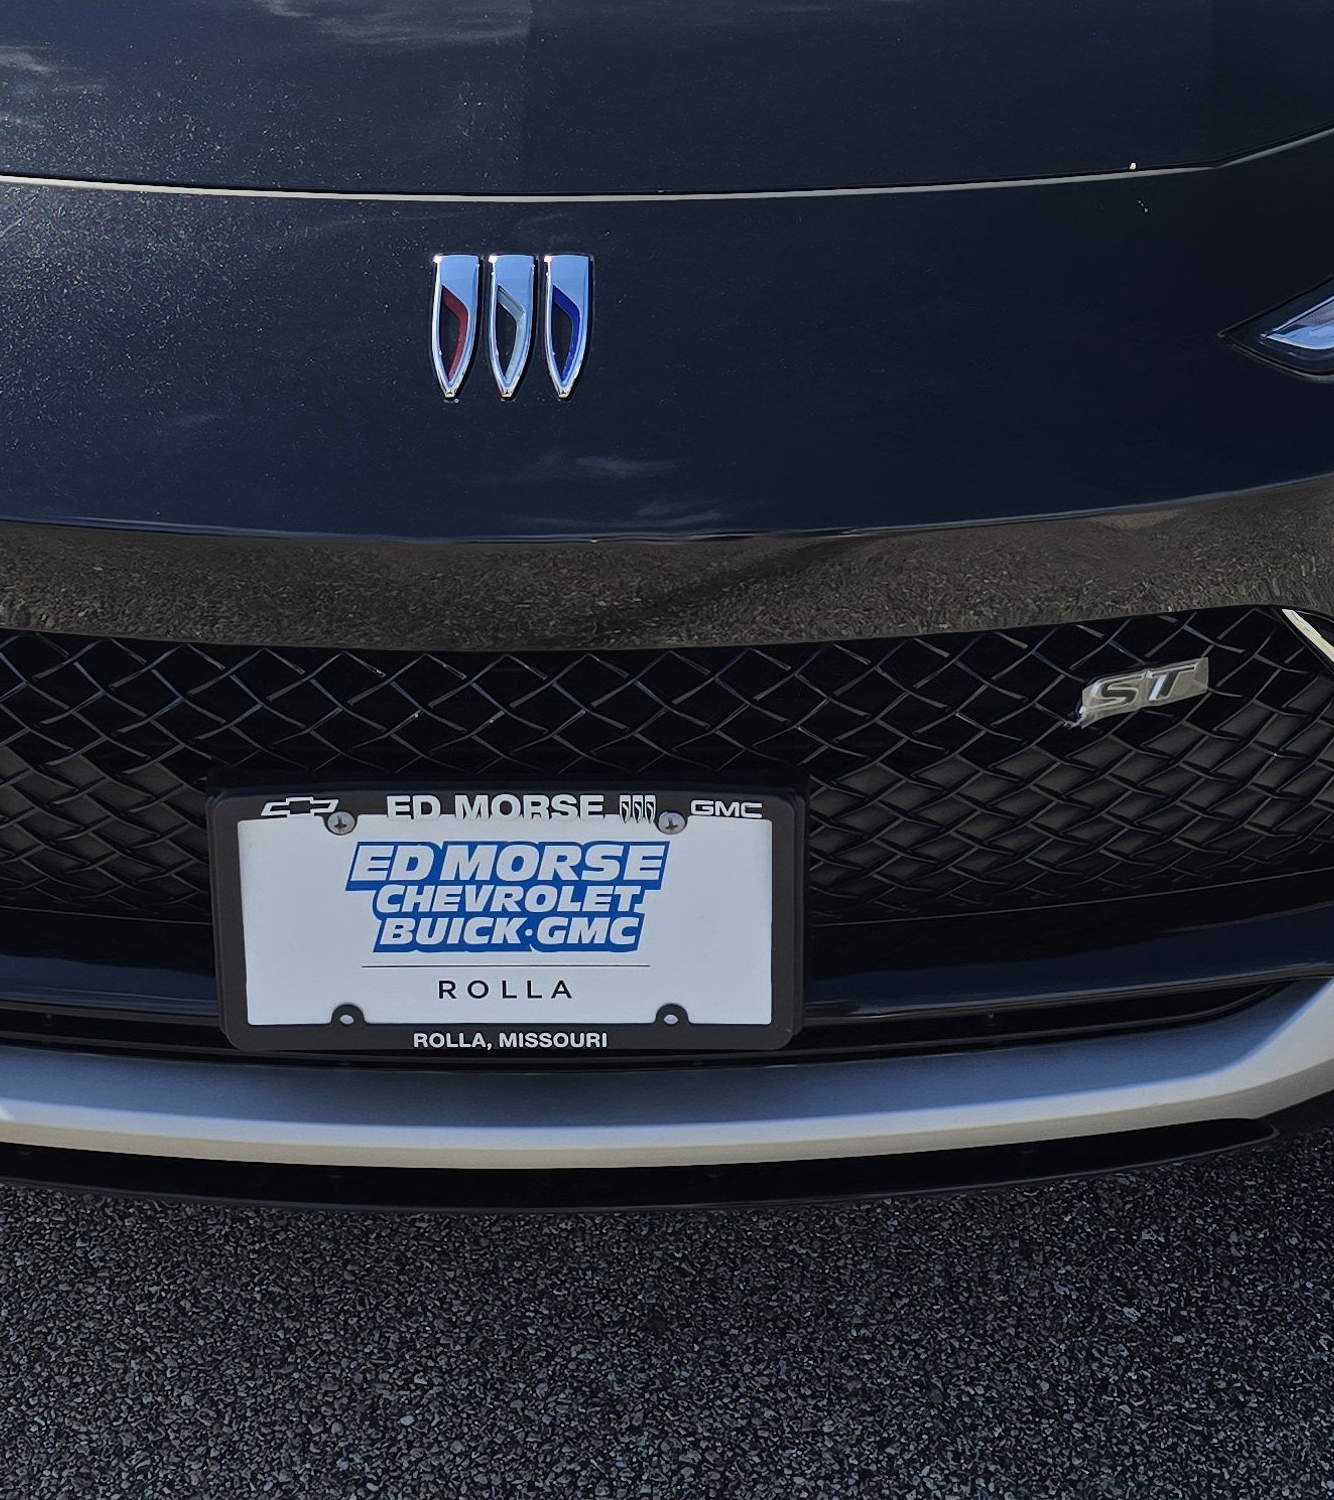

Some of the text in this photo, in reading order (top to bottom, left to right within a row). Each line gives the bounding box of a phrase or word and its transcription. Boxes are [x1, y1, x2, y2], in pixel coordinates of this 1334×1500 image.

[1084, 661, 1199, 712] ST
[386, 794, 763, 822] ED MORSE GMC
[350, 844, 665, 881] ED MORSE
[376, 884, 643, 914] CHEVROLET
[438, 980, 573, 1000] ROLLA
[413, 1032, 608, 1050] ROLLA, MISSOURI
